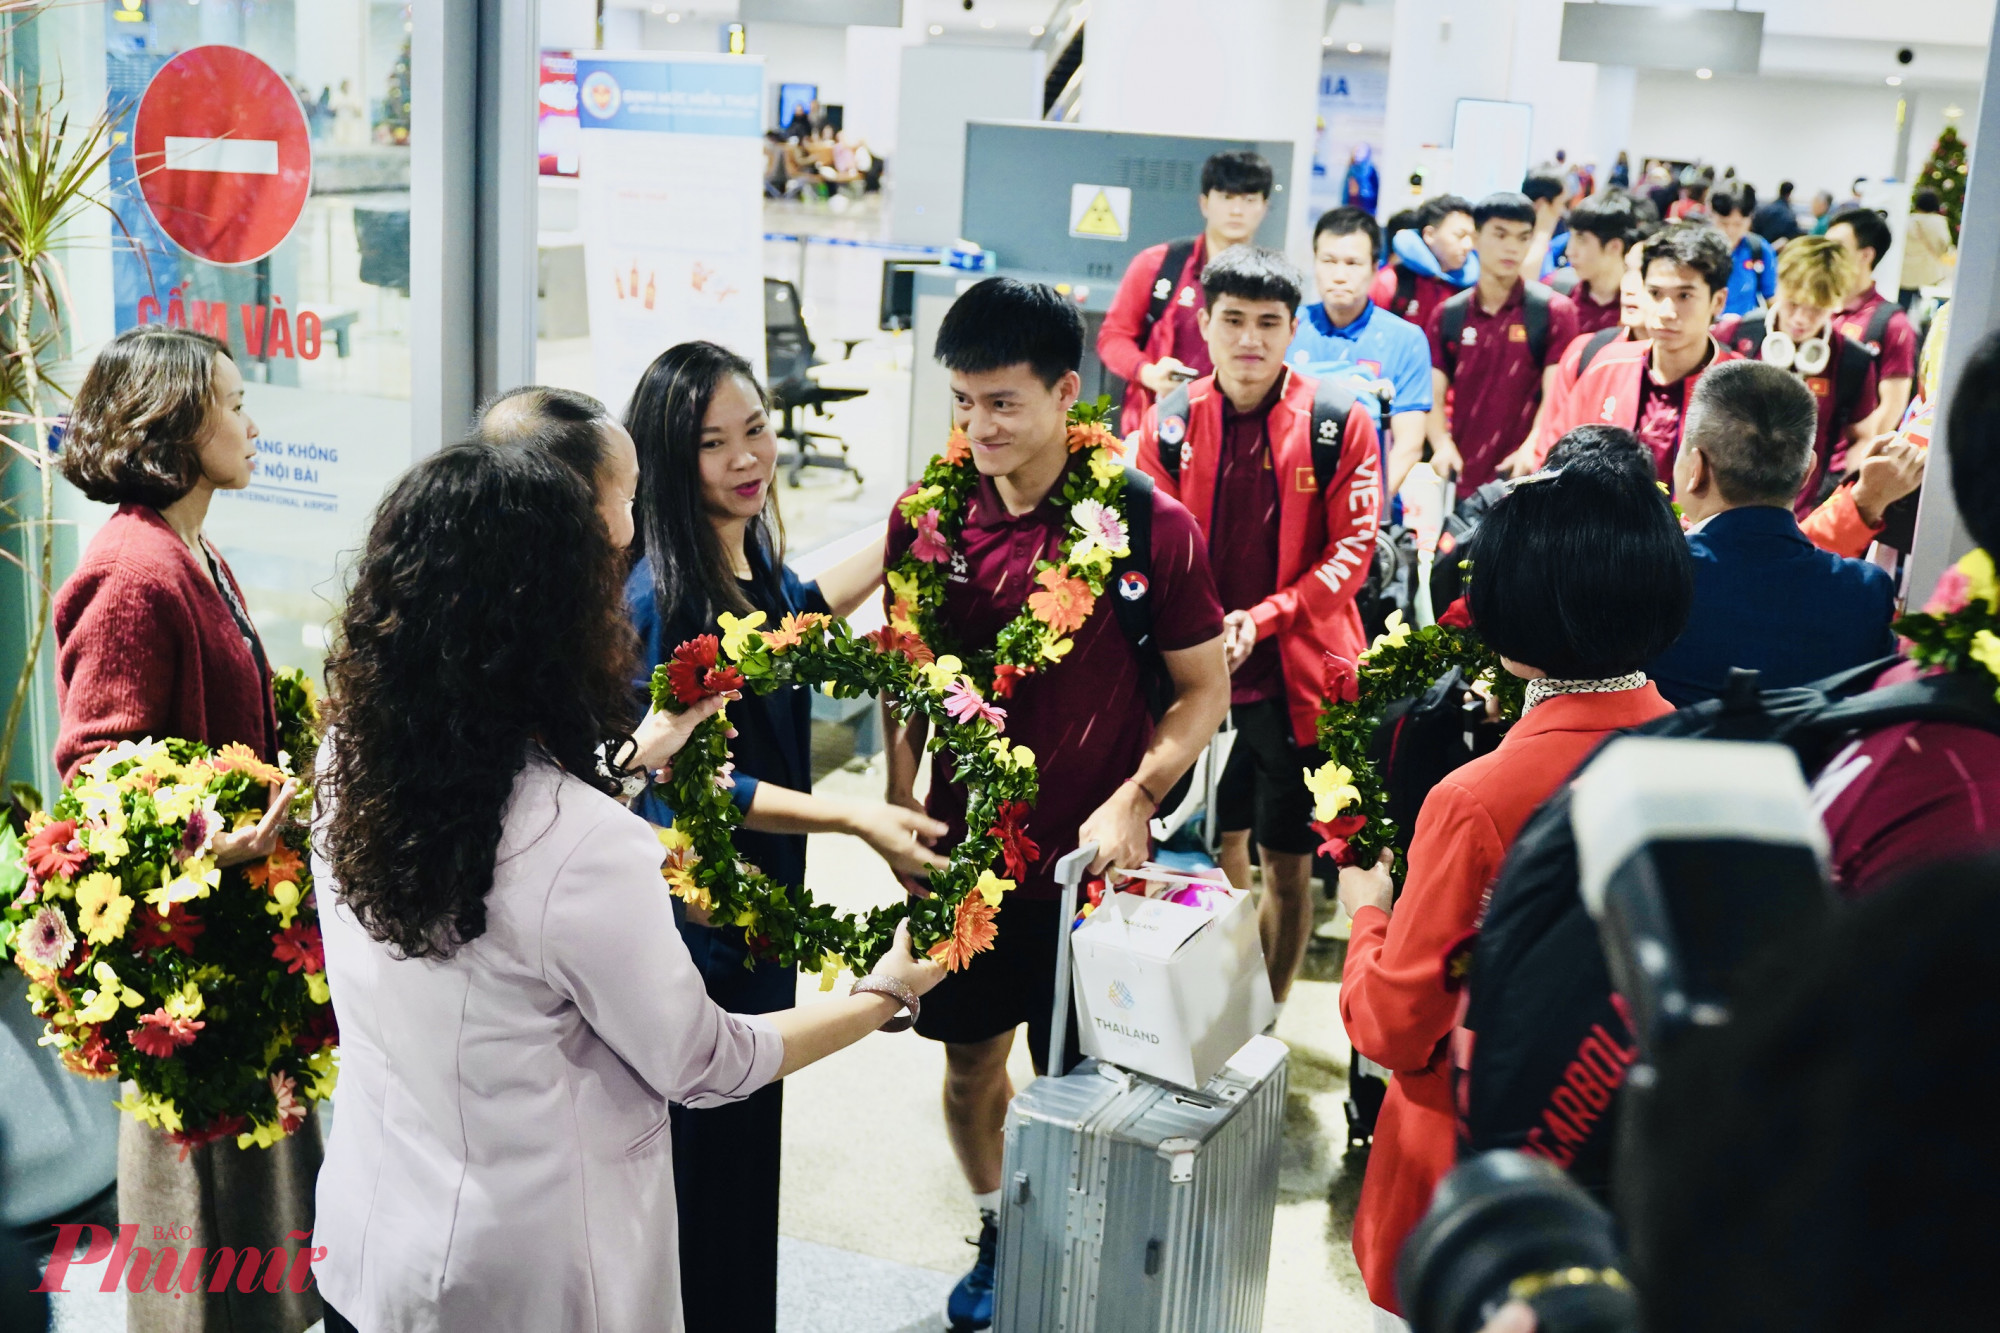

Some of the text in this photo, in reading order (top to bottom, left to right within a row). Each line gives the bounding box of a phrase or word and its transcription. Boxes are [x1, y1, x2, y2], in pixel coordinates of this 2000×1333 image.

[240, 294, 322, 361] VÀO
[287, 442, 338, 462] KHÔNG
[264, 461, 289, 482] NỘI
[294, 464, 318, 483] BÀI
[235, 490, 301, 508] INTERNATIONAL
[303, 500, 338, 513] AIRPORT
[1314, 453, 1379, 593] VIETNAM
[1095, 1016, 1160, 1045] THAILAND
